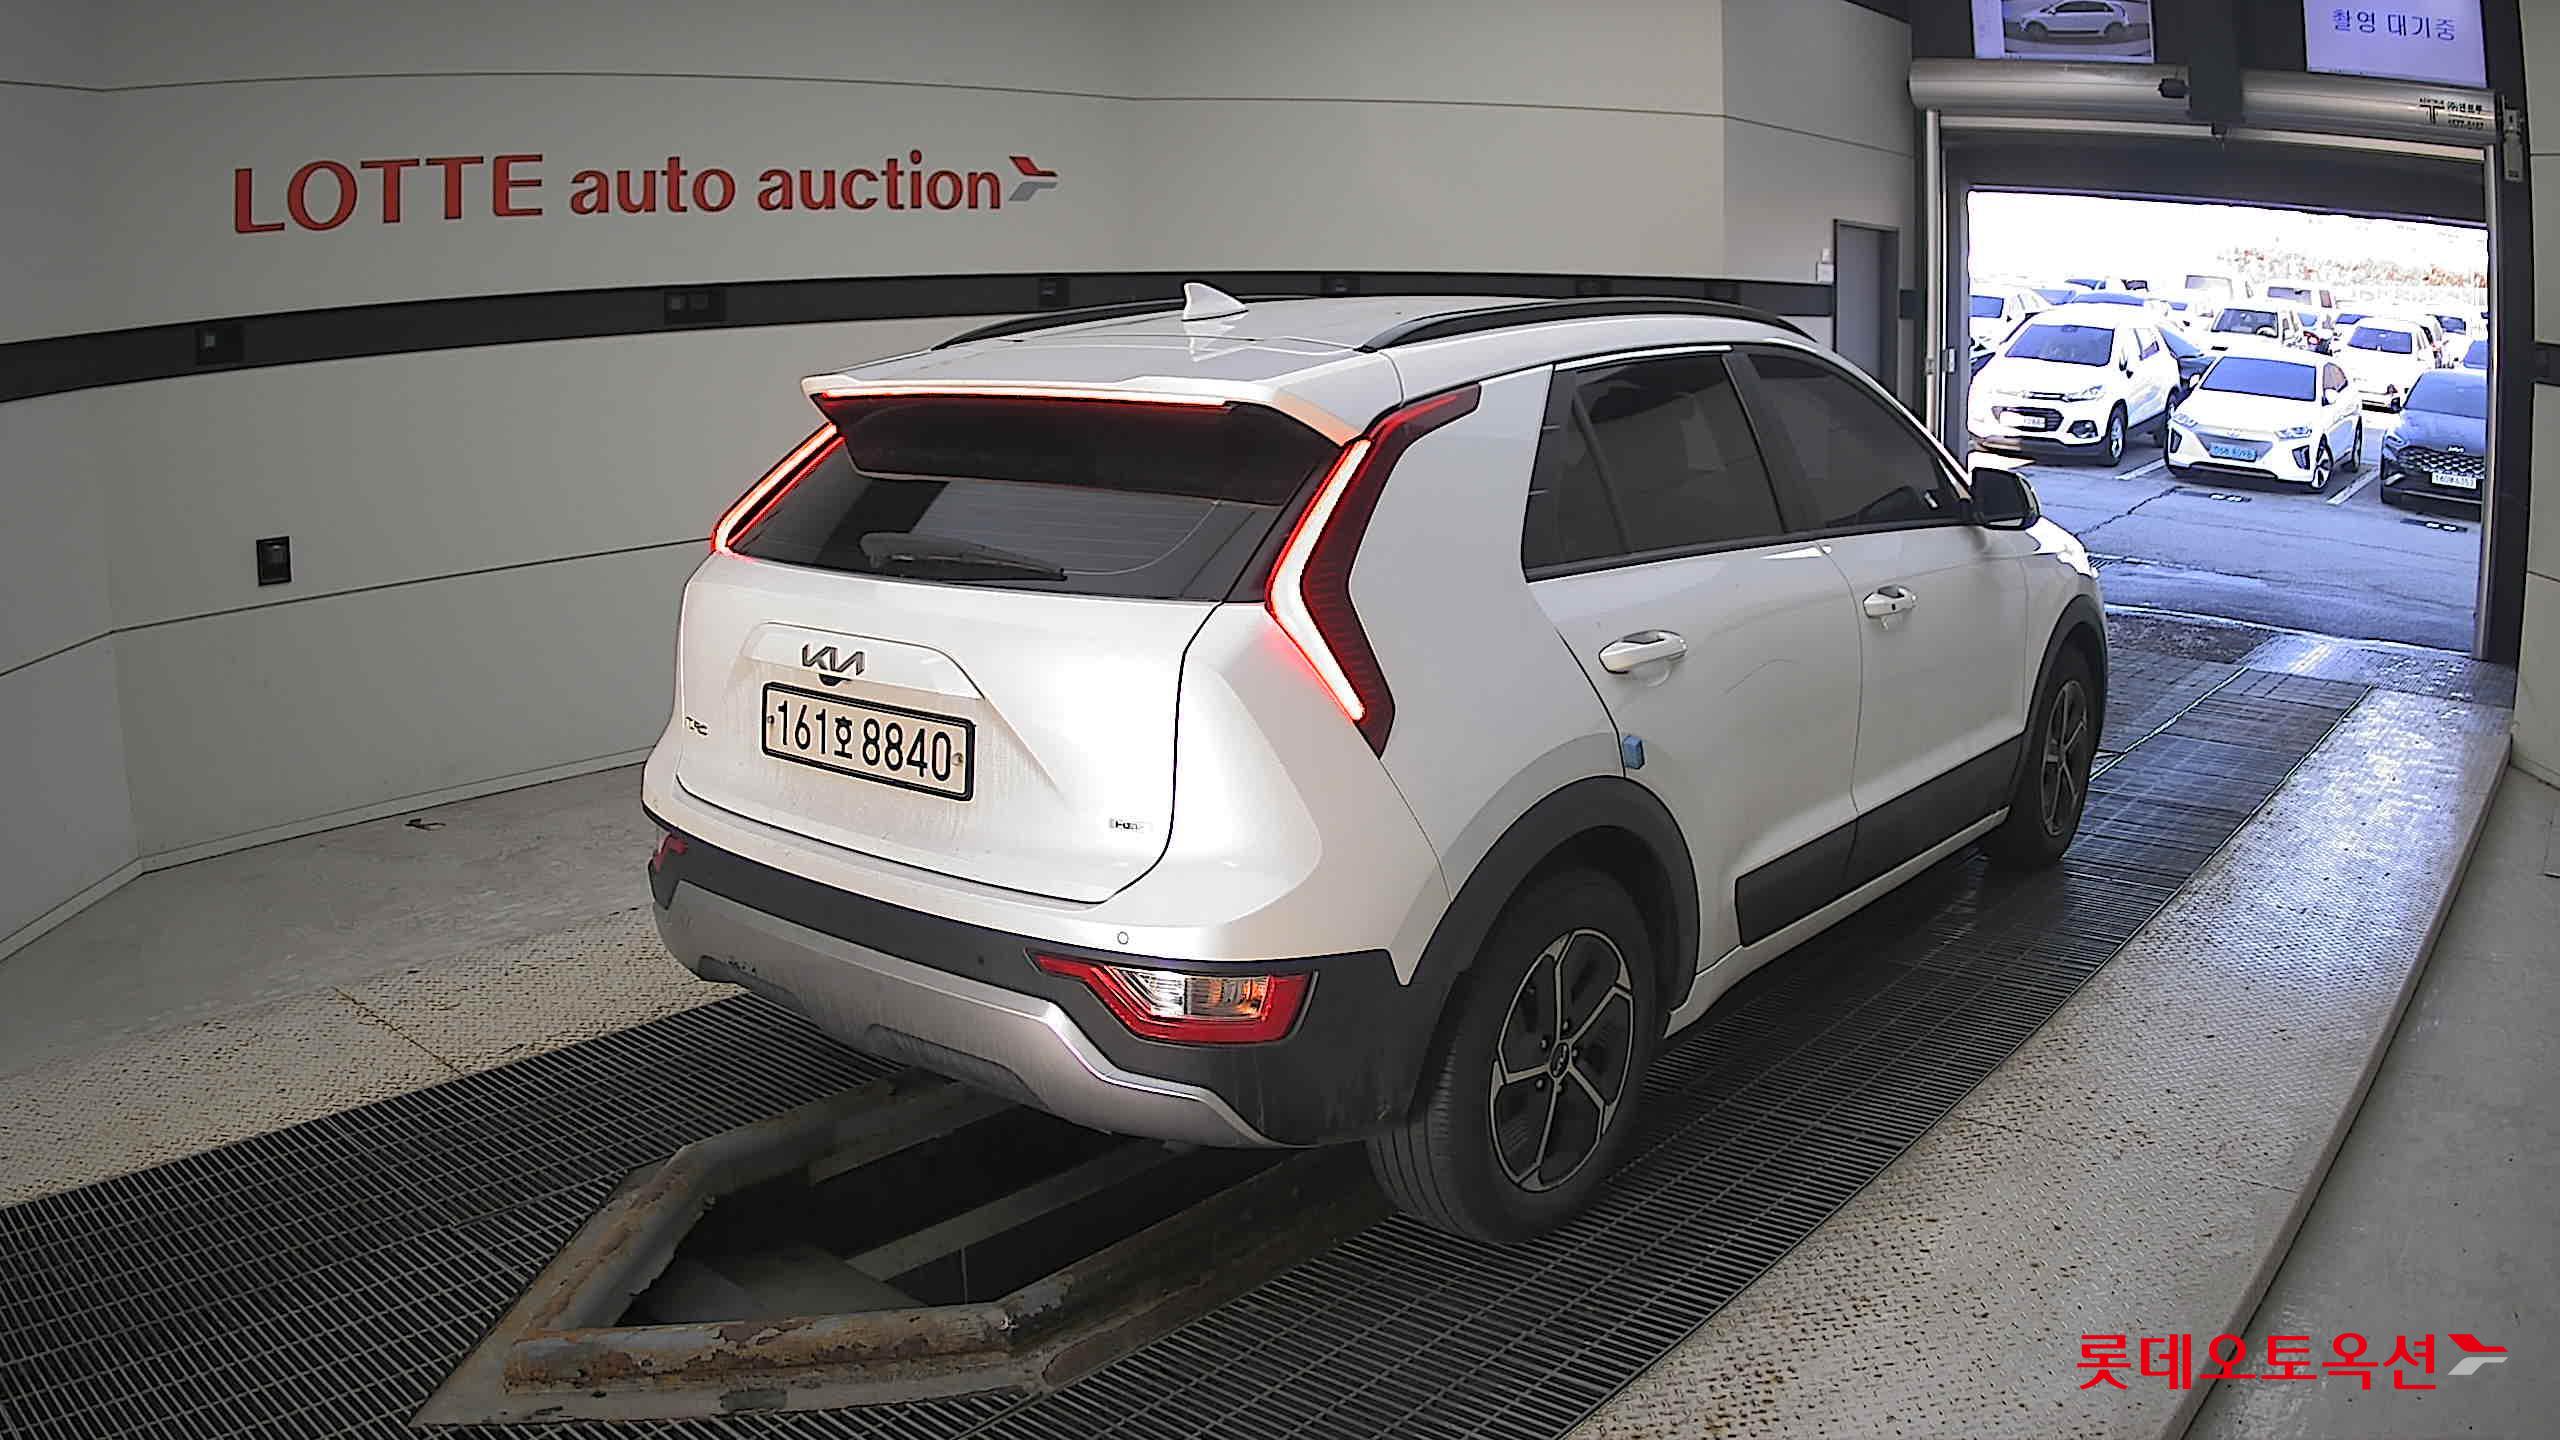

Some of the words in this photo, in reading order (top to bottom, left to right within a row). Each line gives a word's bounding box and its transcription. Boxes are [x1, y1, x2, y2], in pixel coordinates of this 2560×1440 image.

[2333, 9, 2376, 34] 촬영
[2387, 13, 2456, 41] 대기중
[233, 153, 544, 234] LOTTE
[569, 156, 736, 215] auto
[757, 149, 1002, 211] auction
